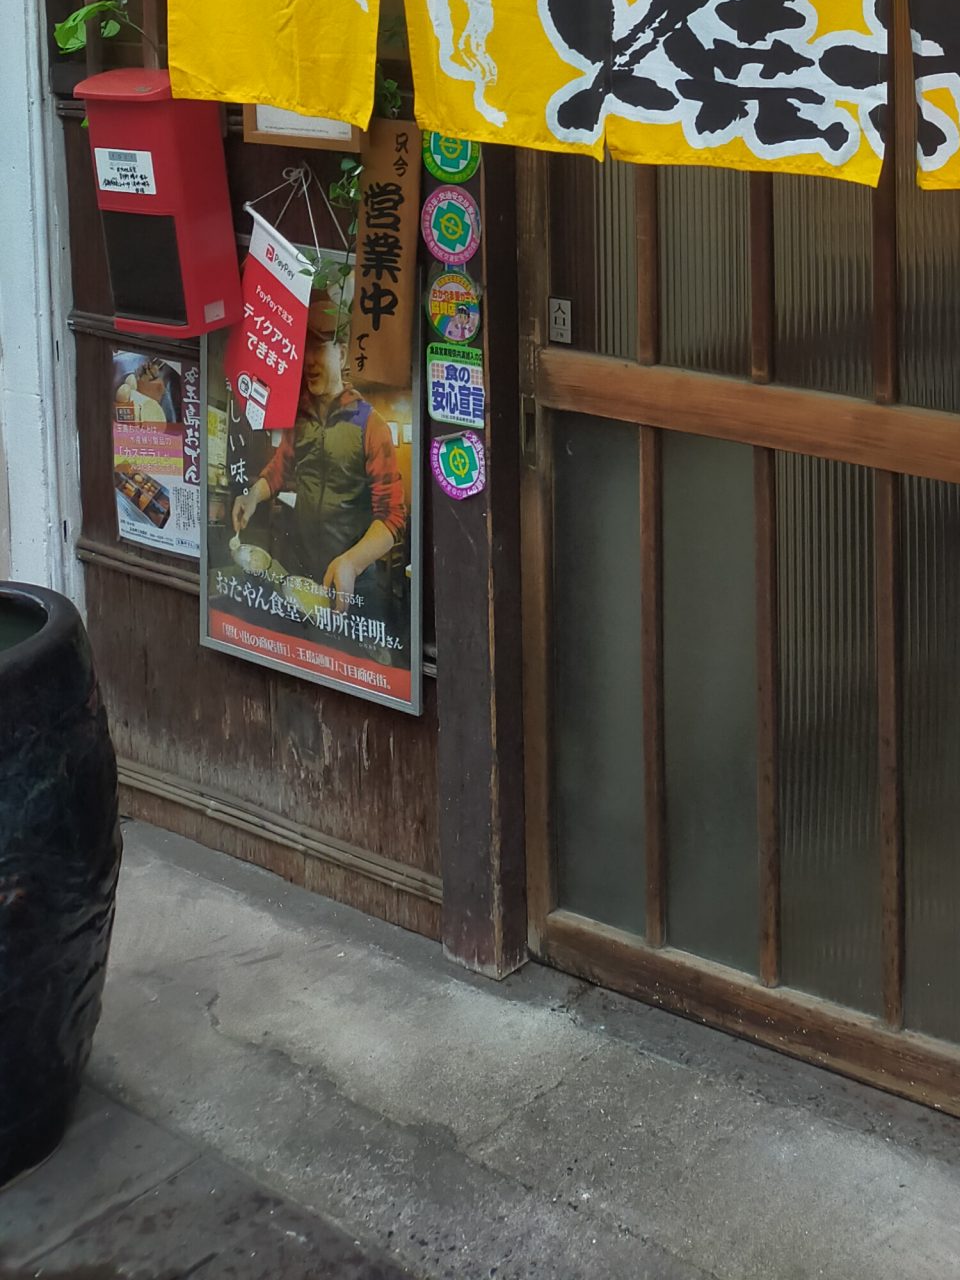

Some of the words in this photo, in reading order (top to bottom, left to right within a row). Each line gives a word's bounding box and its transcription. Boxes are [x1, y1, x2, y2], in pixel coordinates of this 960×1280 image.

[274, 252, 296, 281] PayPay
[360, 181, 405, 332] 営業中
[243, 302, 298, 361] テイクアウト
[246, 331, 289, 375] できます
[354, 333, 370, 372] です
[444, 363, 471, 384] 食の
[432, 380, 485, 420] 安心宣言
